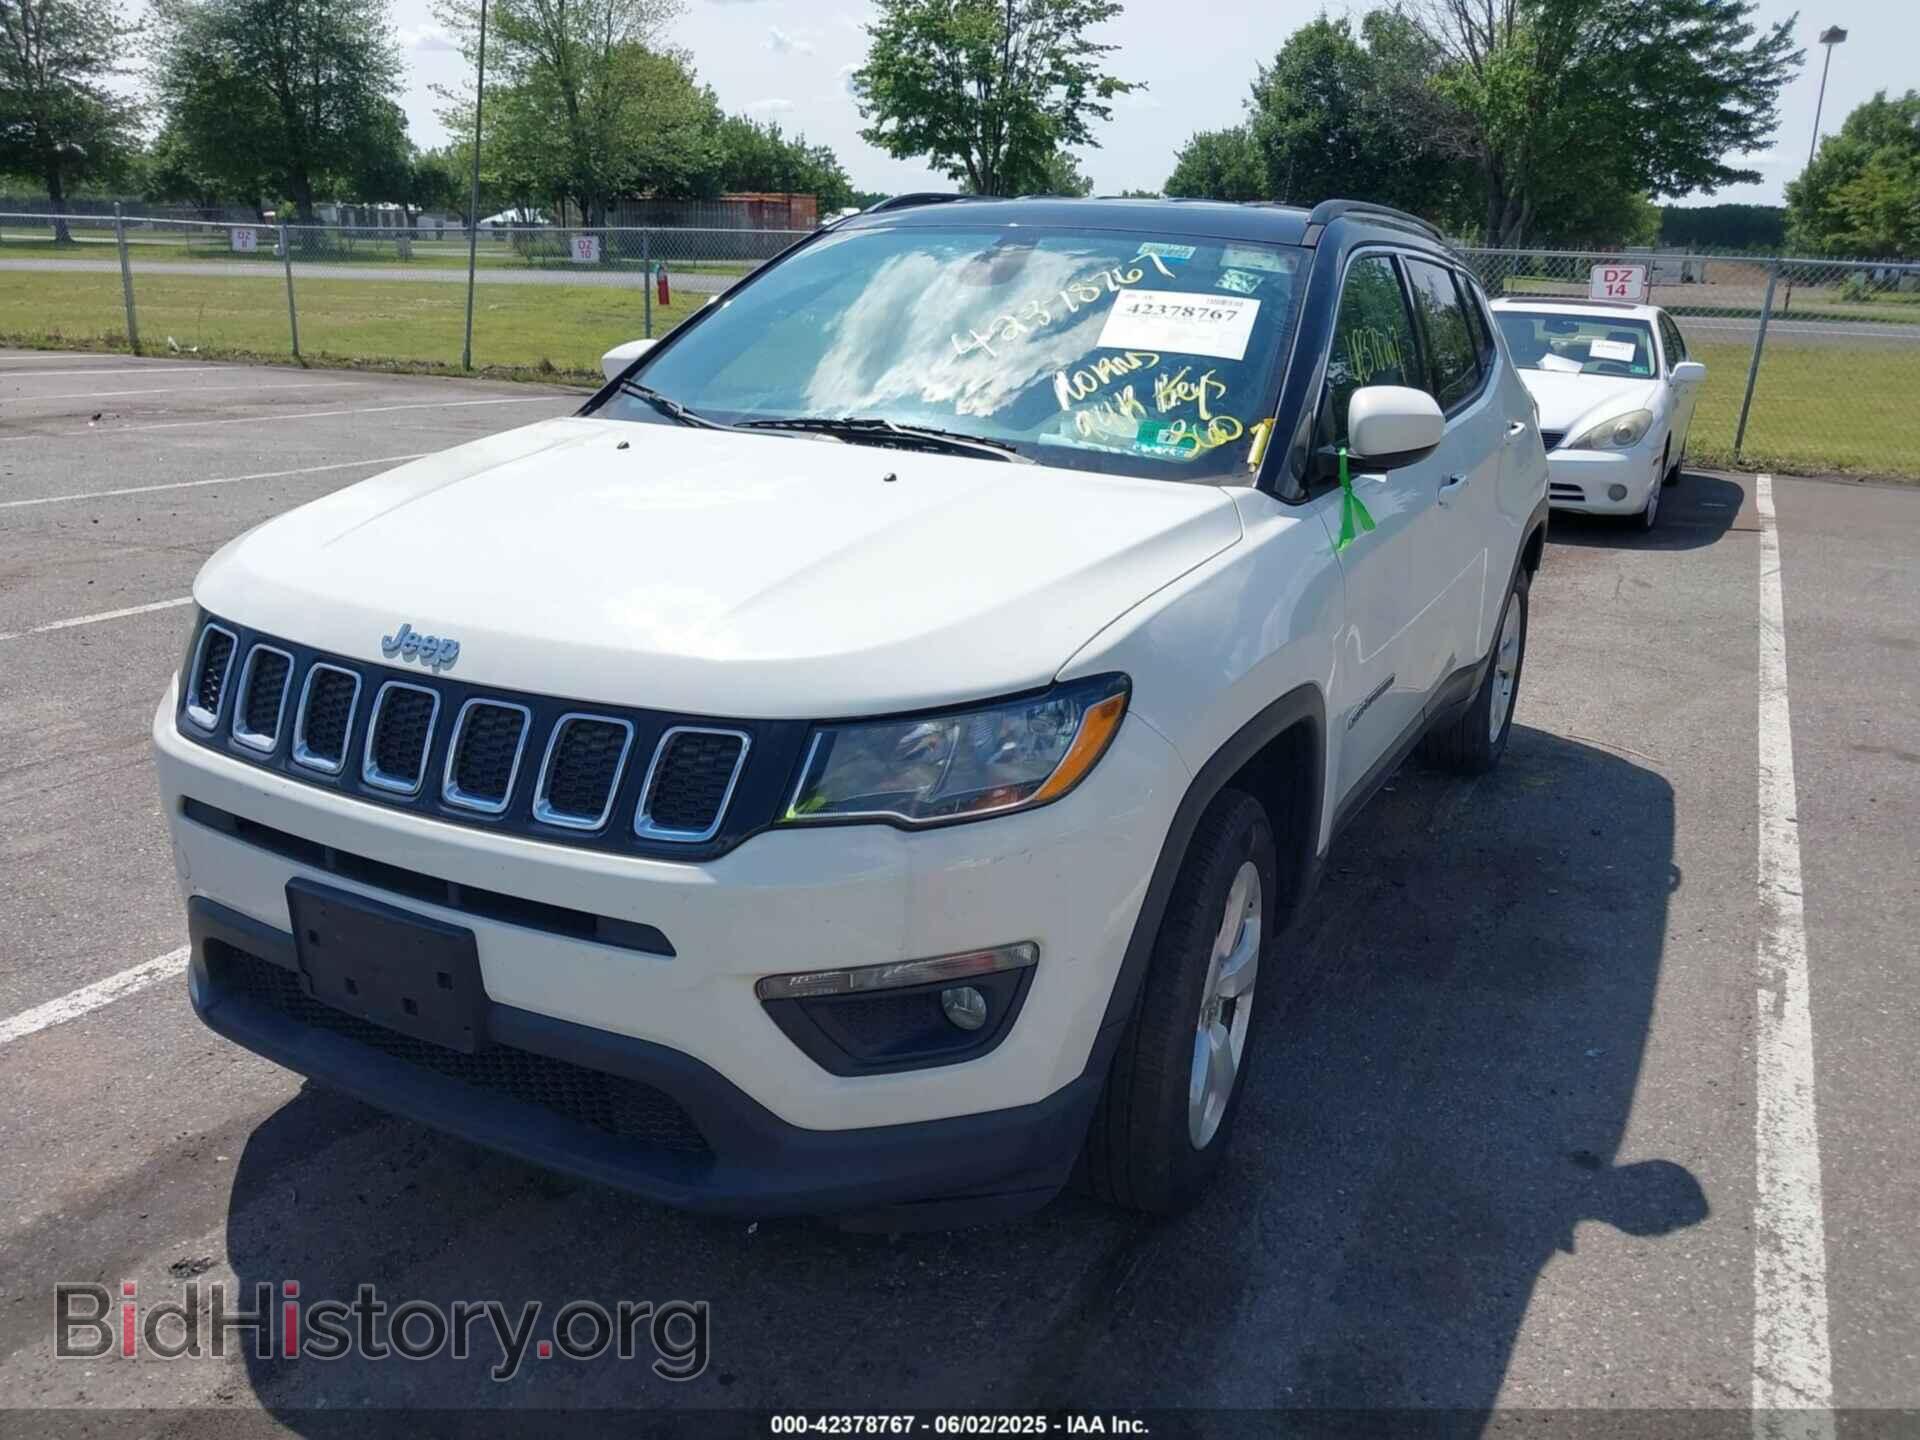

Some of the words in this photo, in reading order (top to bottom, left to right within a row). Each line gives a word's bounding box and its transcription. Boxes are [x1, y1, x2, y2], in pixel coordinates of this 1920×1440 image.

[1604, 270, 1633, 282] DZ
[1606, 284, 1627, 296] 14
[1126, 302, 1239, 322] 42378767
[381, 623, 460, 673] Jeep
